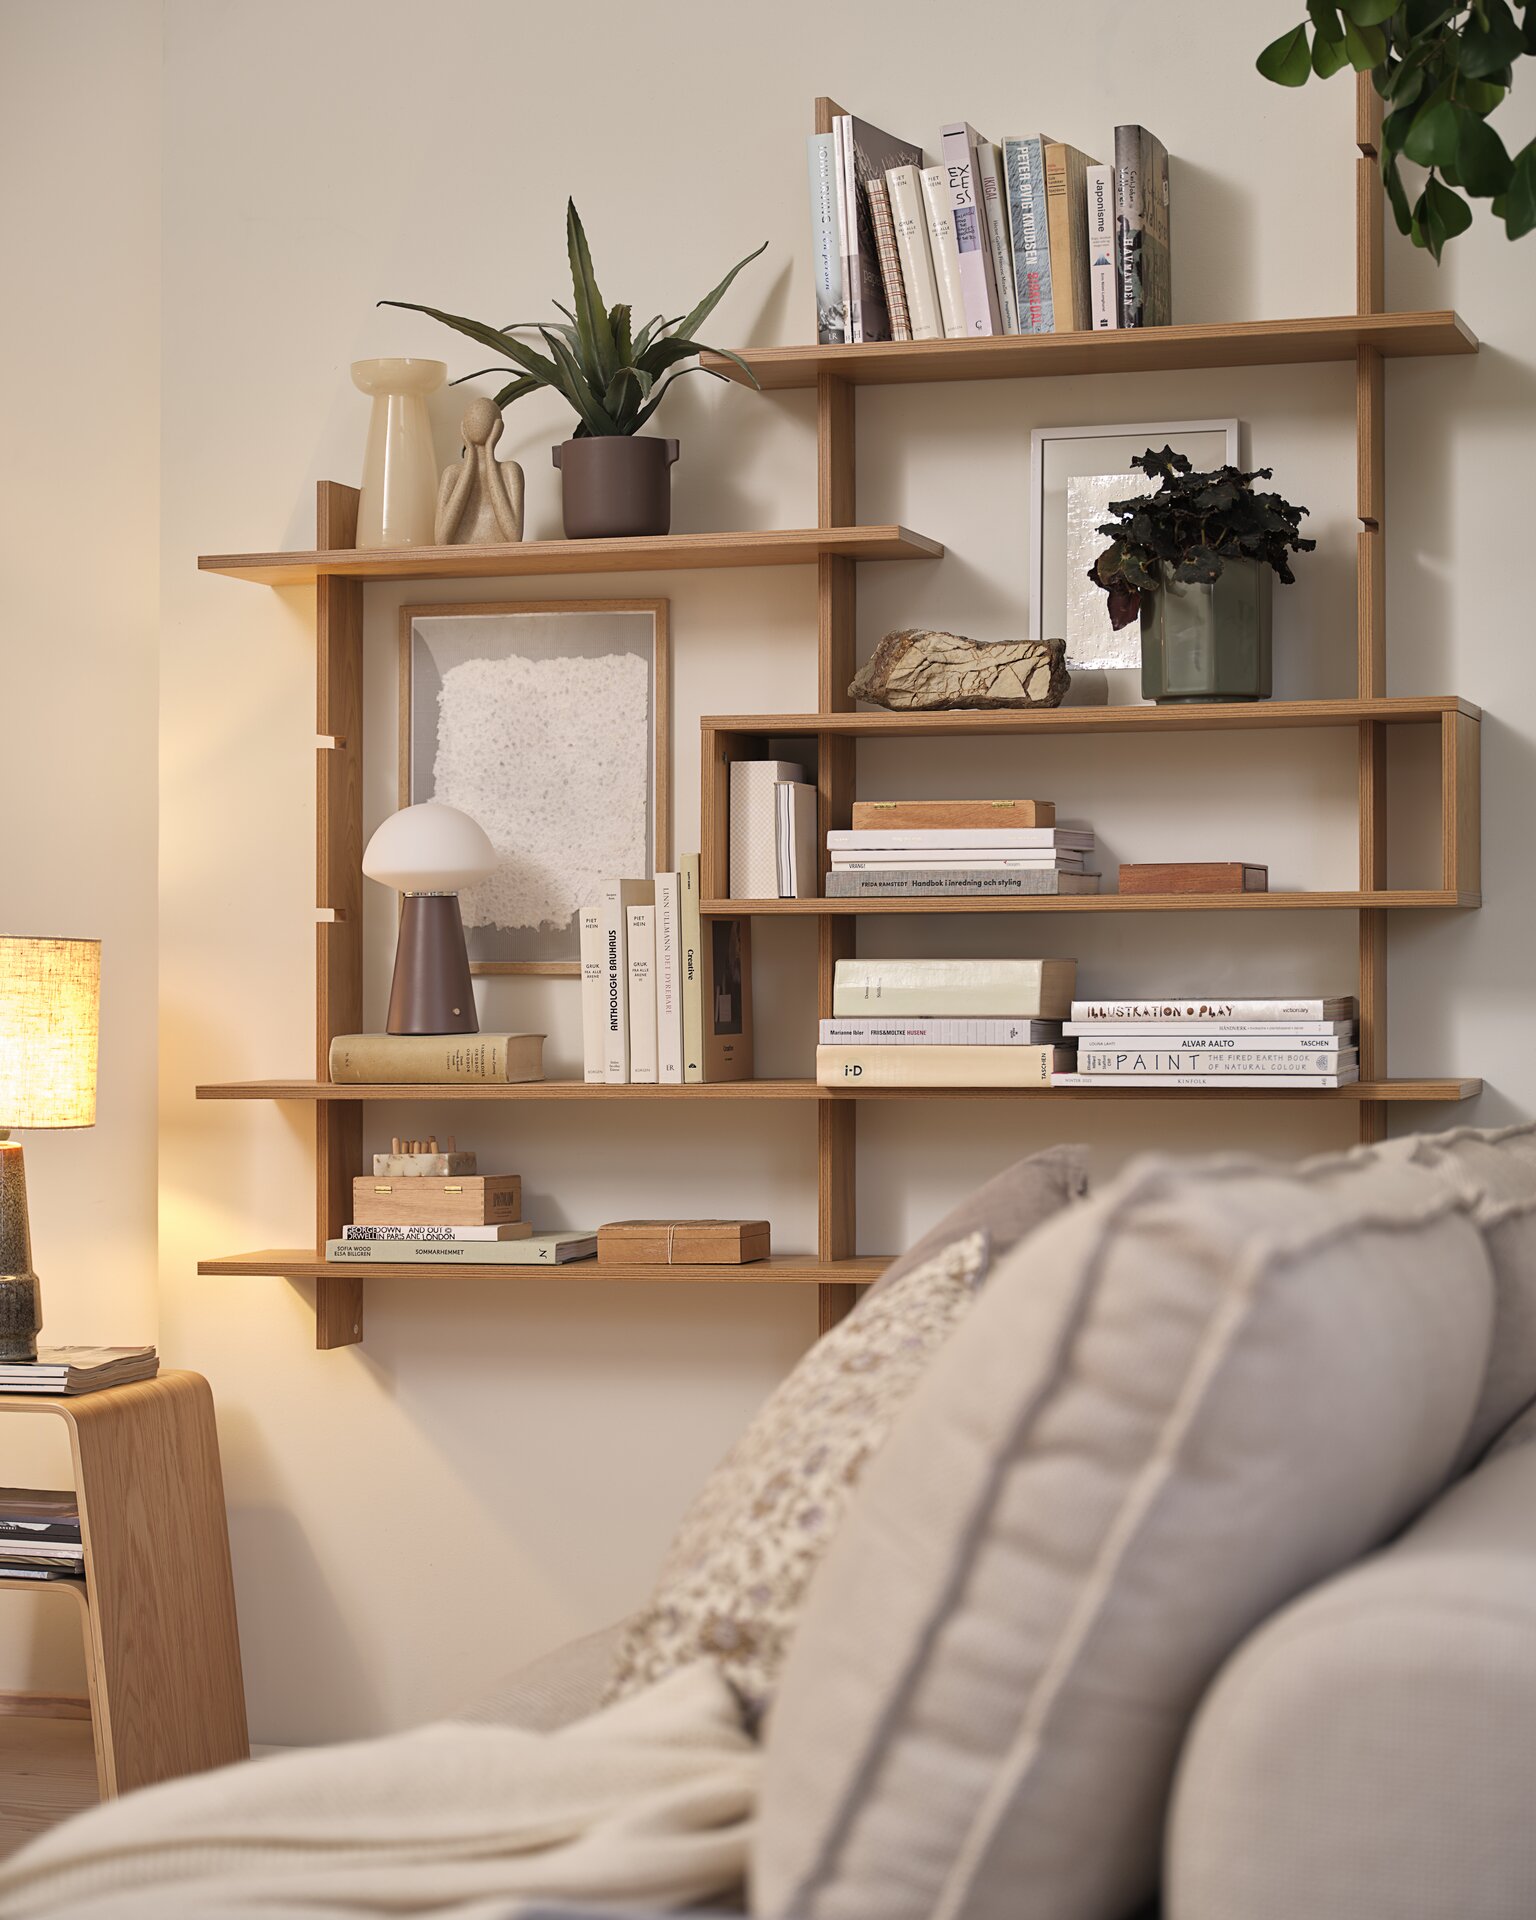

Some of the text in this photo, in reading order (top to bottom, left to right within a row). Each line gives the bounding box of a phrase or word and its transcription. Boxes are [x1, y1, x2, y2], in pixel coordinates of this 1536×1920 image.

[984, 176, 998, 200] IKIGAI
[1017, 146, 1038, 264] PETER ØVIG KNUDSEN
[1094, 180, 1106, 232] Japonisme
[1124, 236, 1134, 306] HAVMANDEN
[949, 879, 981, 887] inredning
[998, 879, 1022, 887] styling
[609, 930, 618, 1031] ANTHOLOGIE BAUHAUS
[1088, 1005, 1232, 1018] ILLUSTRATION PLAY
[1116, 1054, 1199, 1070] PAINT
